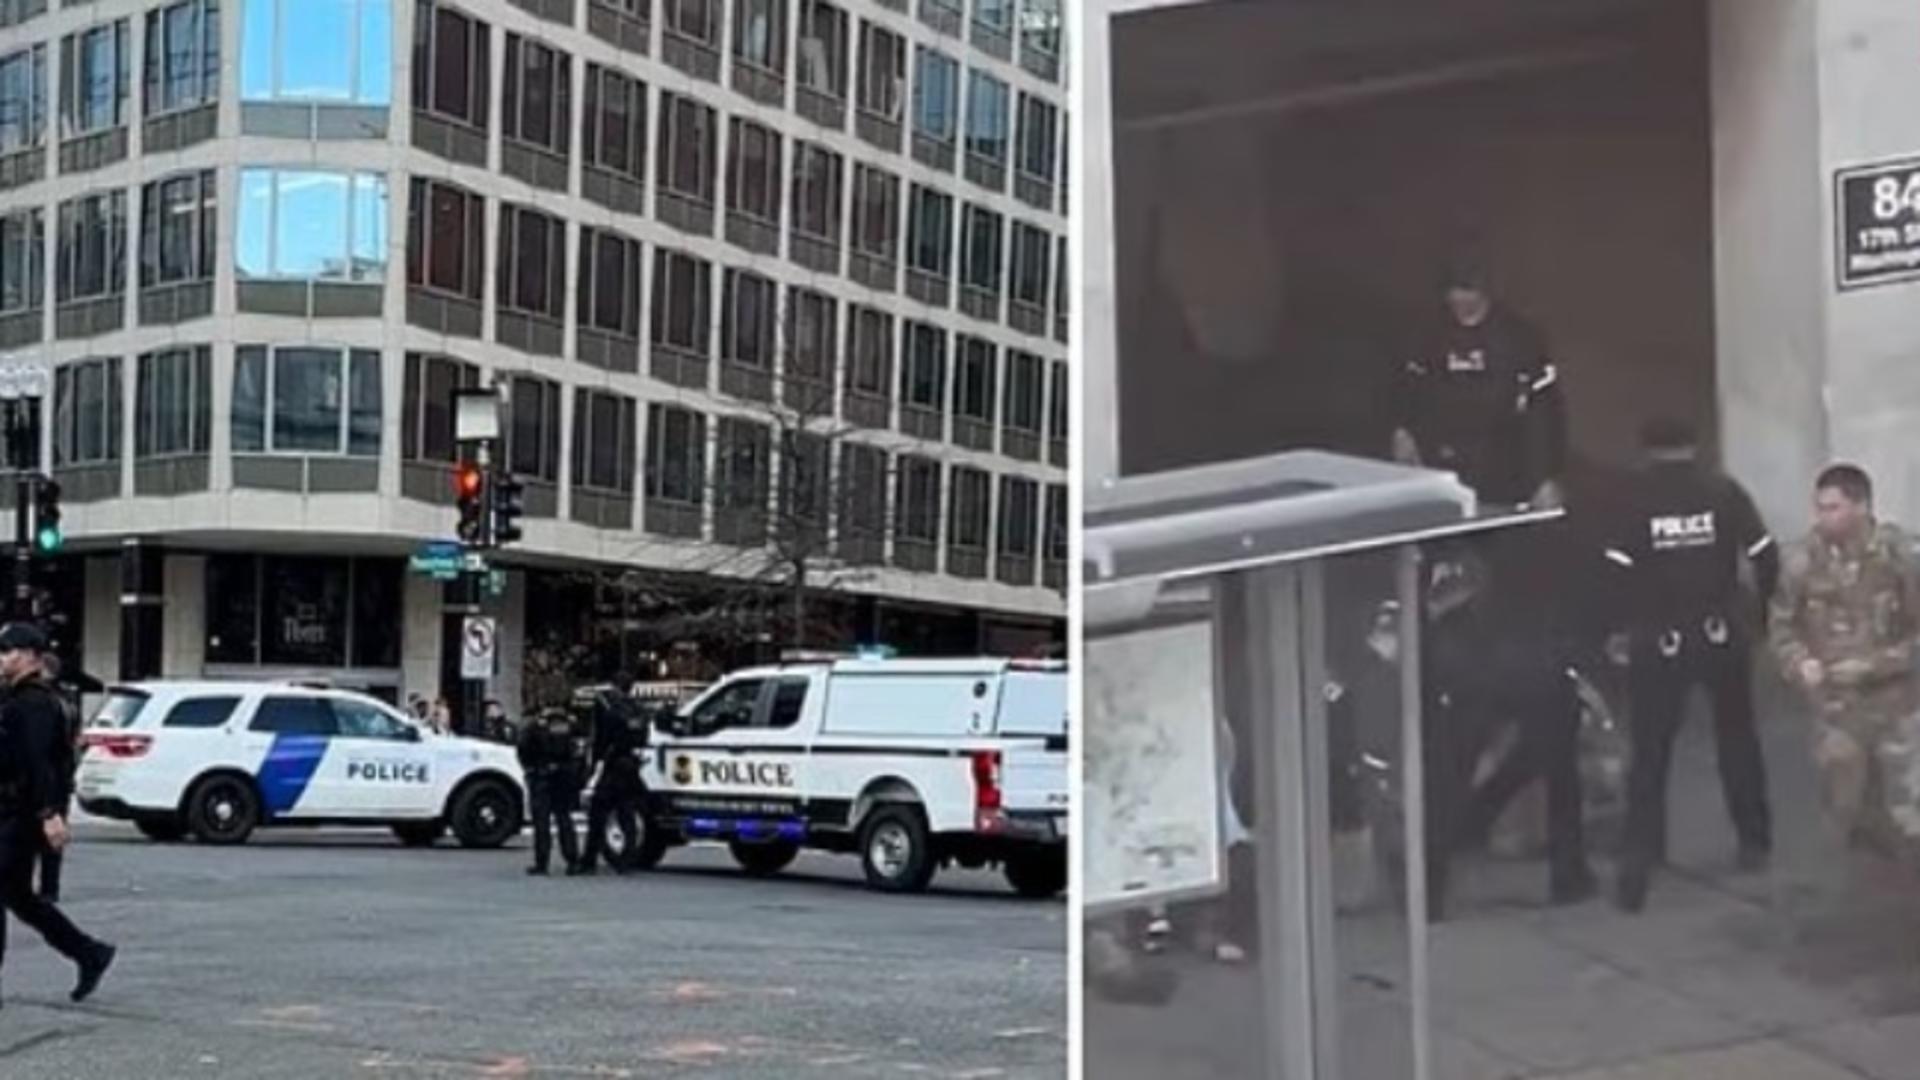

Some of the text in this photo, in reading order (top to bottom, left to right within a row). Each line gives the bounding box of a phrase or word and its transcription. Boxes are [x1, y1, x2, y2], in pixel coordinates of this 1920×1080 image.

[1650, 511, 1714, 537] POLICE
[347, 762, 430, 783] POLICE
[699, 760, 795, 787] POLICE
